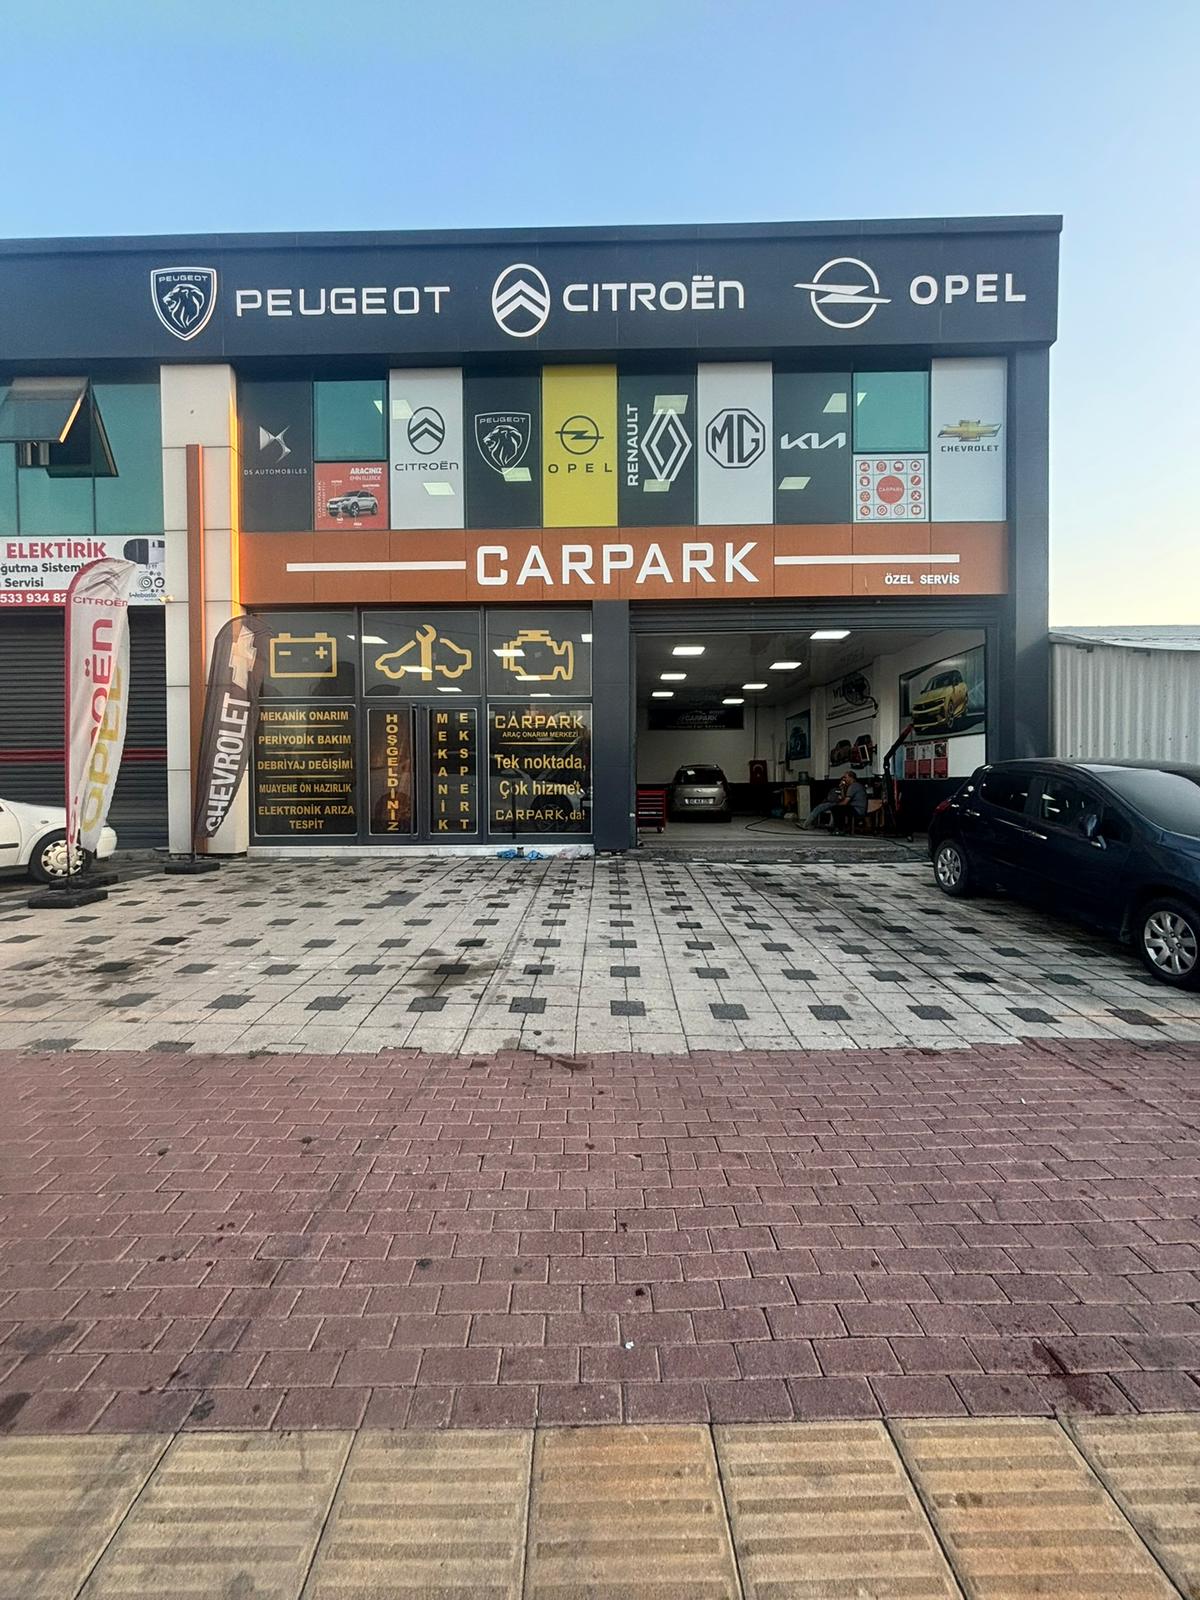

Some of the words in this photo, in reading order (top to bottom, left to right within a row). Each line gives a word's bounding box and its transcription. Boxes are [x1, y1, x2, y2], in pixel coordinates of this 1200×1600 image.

[909, 273, 1027, 305] OPEL
[236, 286, 450, 317] PEUGEOT
[626, 404, 638, 486] RENAULT
[711, 414, 760, 463] MG
[548, 463, 612, 473] OPEL
[6, 538, 107, 559] ELEKTİRİK
[476, 542, 760, 586] CARPARK
[5, 577, 44, 587] Servisi
[885, 573, 913, 584] ÖZEL
[920, 572, 960, 584] SERVİS
[0, 593, 23, 603] 533
[26, 593, 49, 603] 934
[260, 709, 307, 721] MEKANİK
[309, 711, 349, 720] ONARIM
[495, 715, 584, 729] CARPARK
[258, 733, 314, 745] PERİYODİK
[317, 735, 352, 744] BAKIM
[502, 731, 520, 739] ARAÇ
[549, 730, 579, 738] MERKEZİ
[205, 692, 251, 832] CHEVROLET
[258, 759, 305, 770] DEBRİYAJ
[308, 757, 353, 771] DEĞİŞİMİ
[494, 754, 520, 769] Tek
[524, 754, 586, 771] noktada,
[459, 712, 469, 830] EKSPERT
[259, 784, 298, 793] MUAYENE
[313, 783, 352, 792] HAZIRLIK
[499, 780, 529, 799] Çok
[258, 804, 321, 815] ELEKTRONİK
[324, 805, 355, 814] ARIZA
[289, 818, 325, 829] TESPİT
